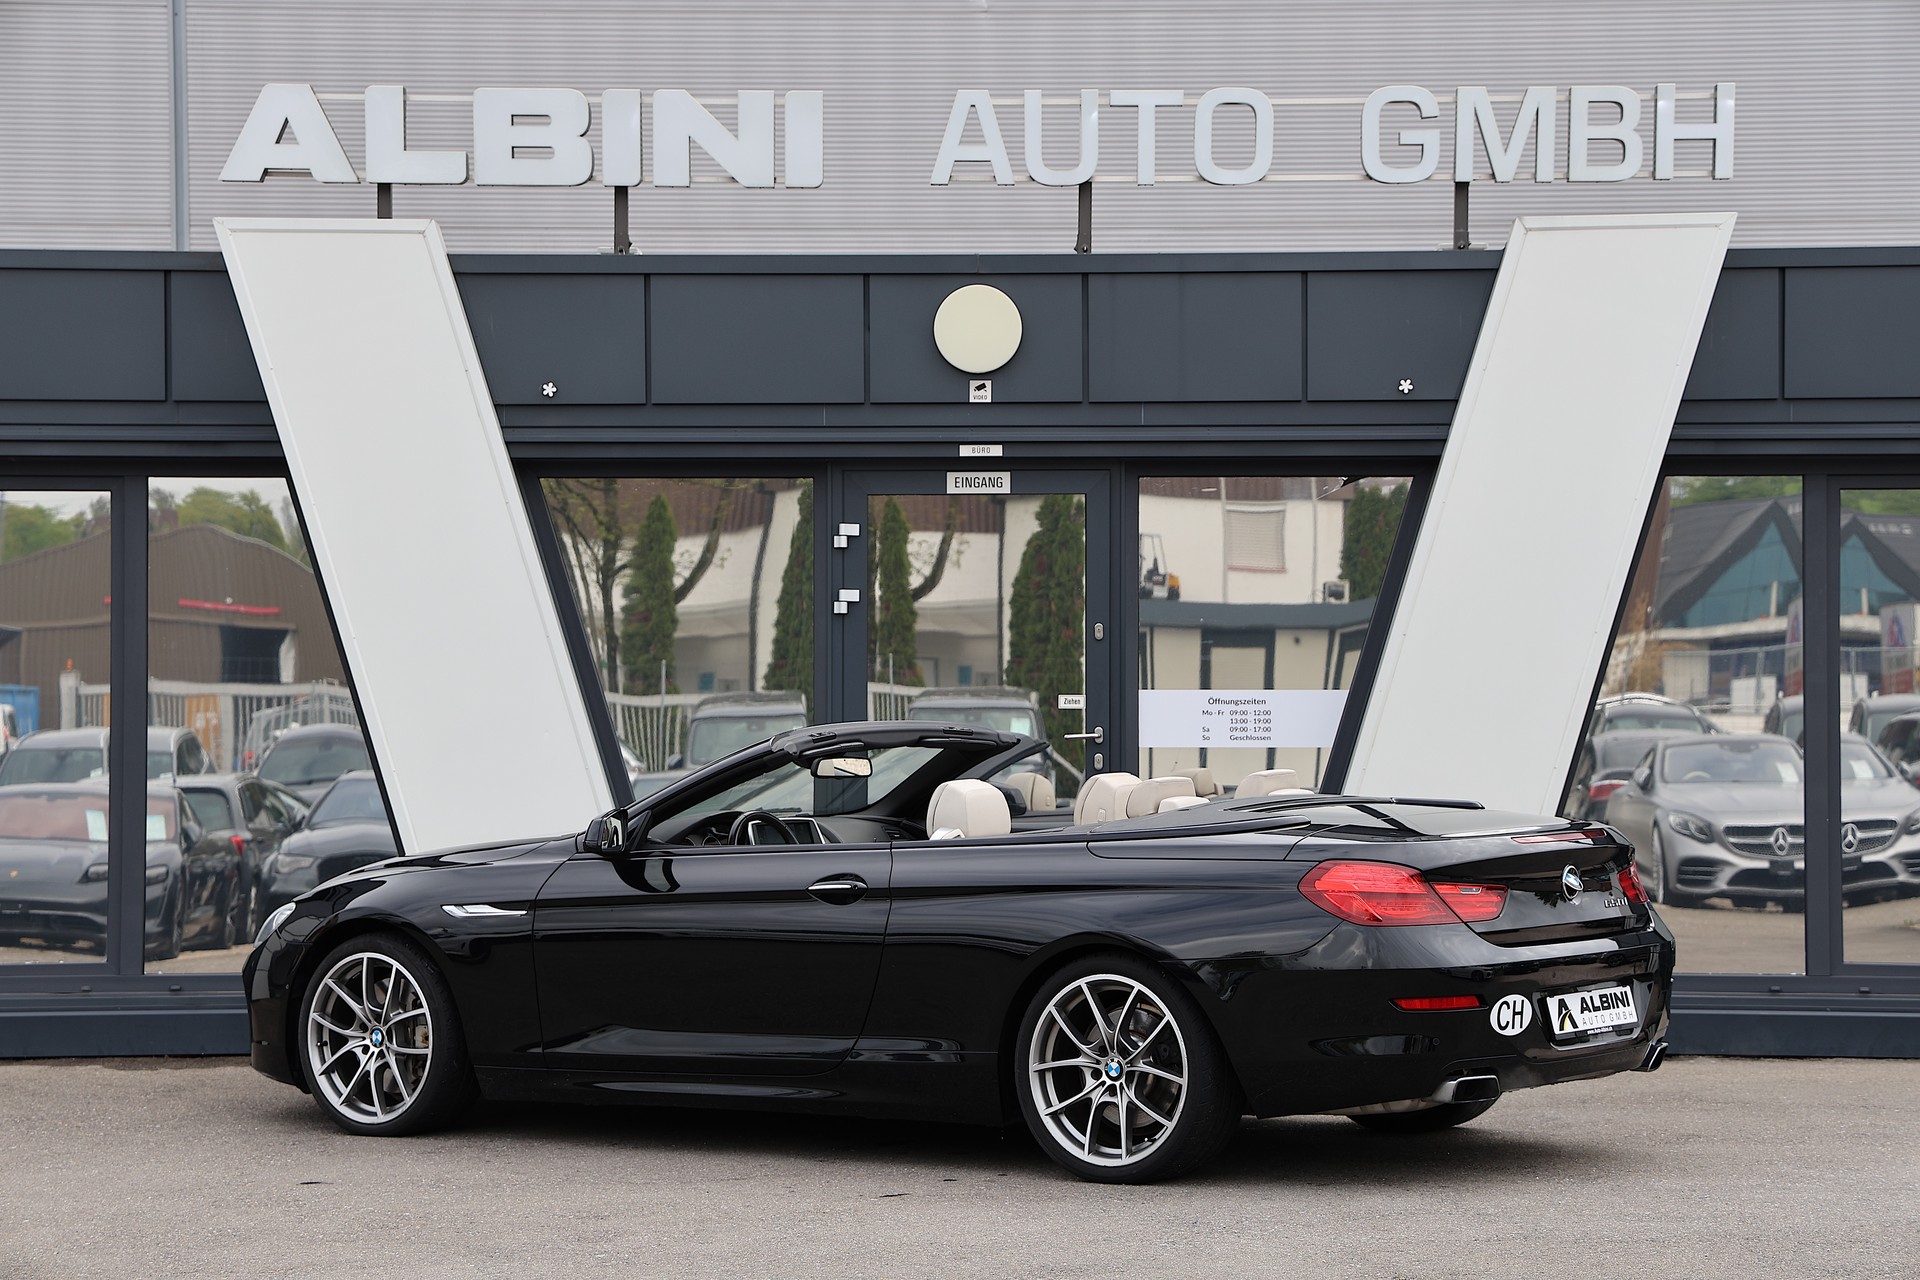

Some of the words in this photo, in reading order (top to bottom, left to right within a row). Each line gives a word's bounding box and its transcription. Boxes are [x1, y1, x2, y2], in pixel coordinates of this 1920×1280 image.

[219, 83, 824, 188] ALBINI
[930, 86, 1275, 187] AUTO
[1361, 82, 1736, 184] GMBH
[972, 446, 991, 454] BÜRO
[954, 476, 1003, 488] EINGANG
[1063, 697, 1081, 705] Ziehen
[1208, 696, 1267, 706] Öffnungszeiten
[1580, 990, 1630, 1014] ALBINI
[1497, 999, 1525, 1031] CH
[1582, 1014, 1606, 1026] AUTO
[1609, 1010, 1635, 1022] GMBH
